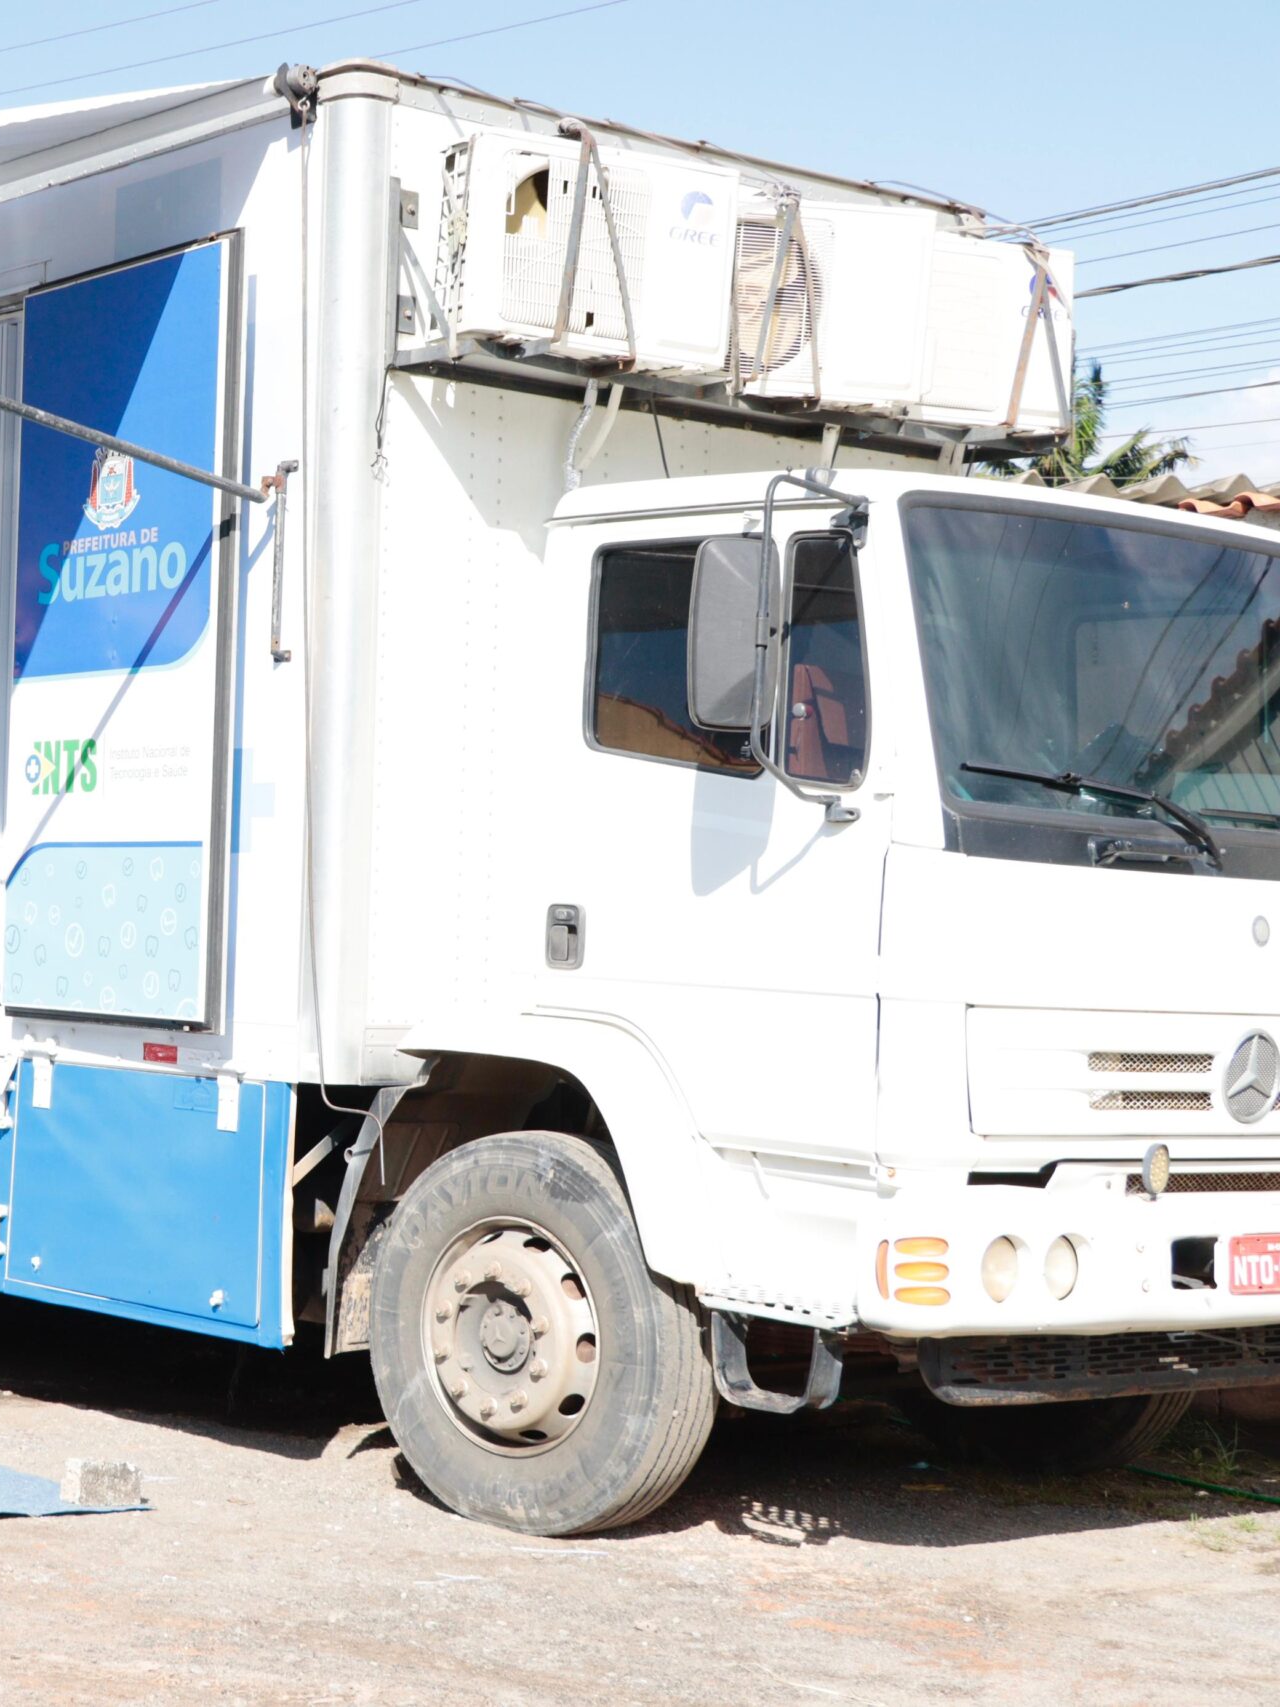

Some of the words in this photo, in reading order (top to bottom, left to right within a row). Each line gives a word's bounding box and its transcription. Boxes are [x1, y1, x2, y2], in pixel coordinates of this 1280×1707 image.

[668, 226, 721, 247] GREE
[63, 530, 137, 555] PREFEITURA
[141, 527, 159, 544] DE
[38, 541, 188, 605] Suzano
